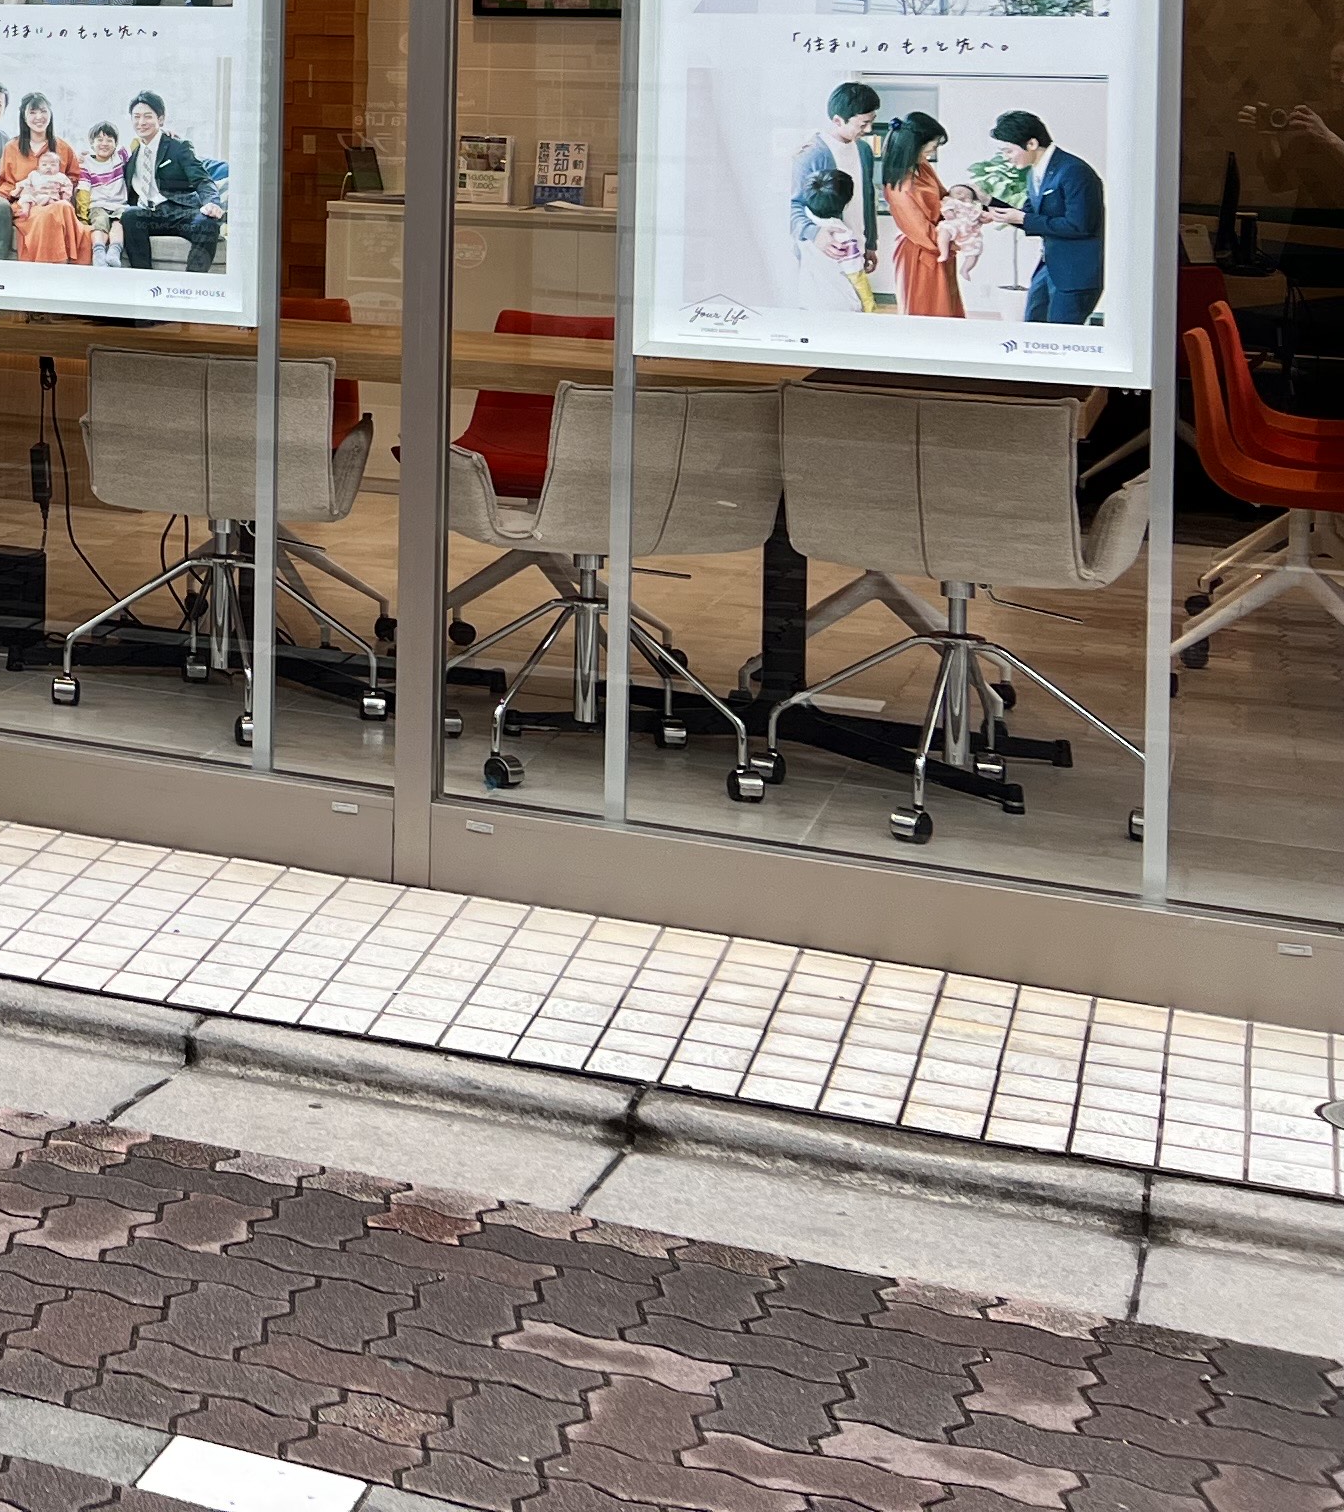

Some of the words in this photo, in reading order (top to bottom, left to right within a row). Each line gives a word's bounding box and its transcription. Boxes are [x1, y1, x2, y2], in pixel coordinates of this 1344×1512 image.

[553, 143, 570, 185] 売却の
[166, 287, 192, 295] TOHO
[689, 306, 721, 323] Your
[724, 307, 749, 325] Life
[1023, 341, 1060, 351] TOHO
[1063, 344, 1104, 353] HOUSE
